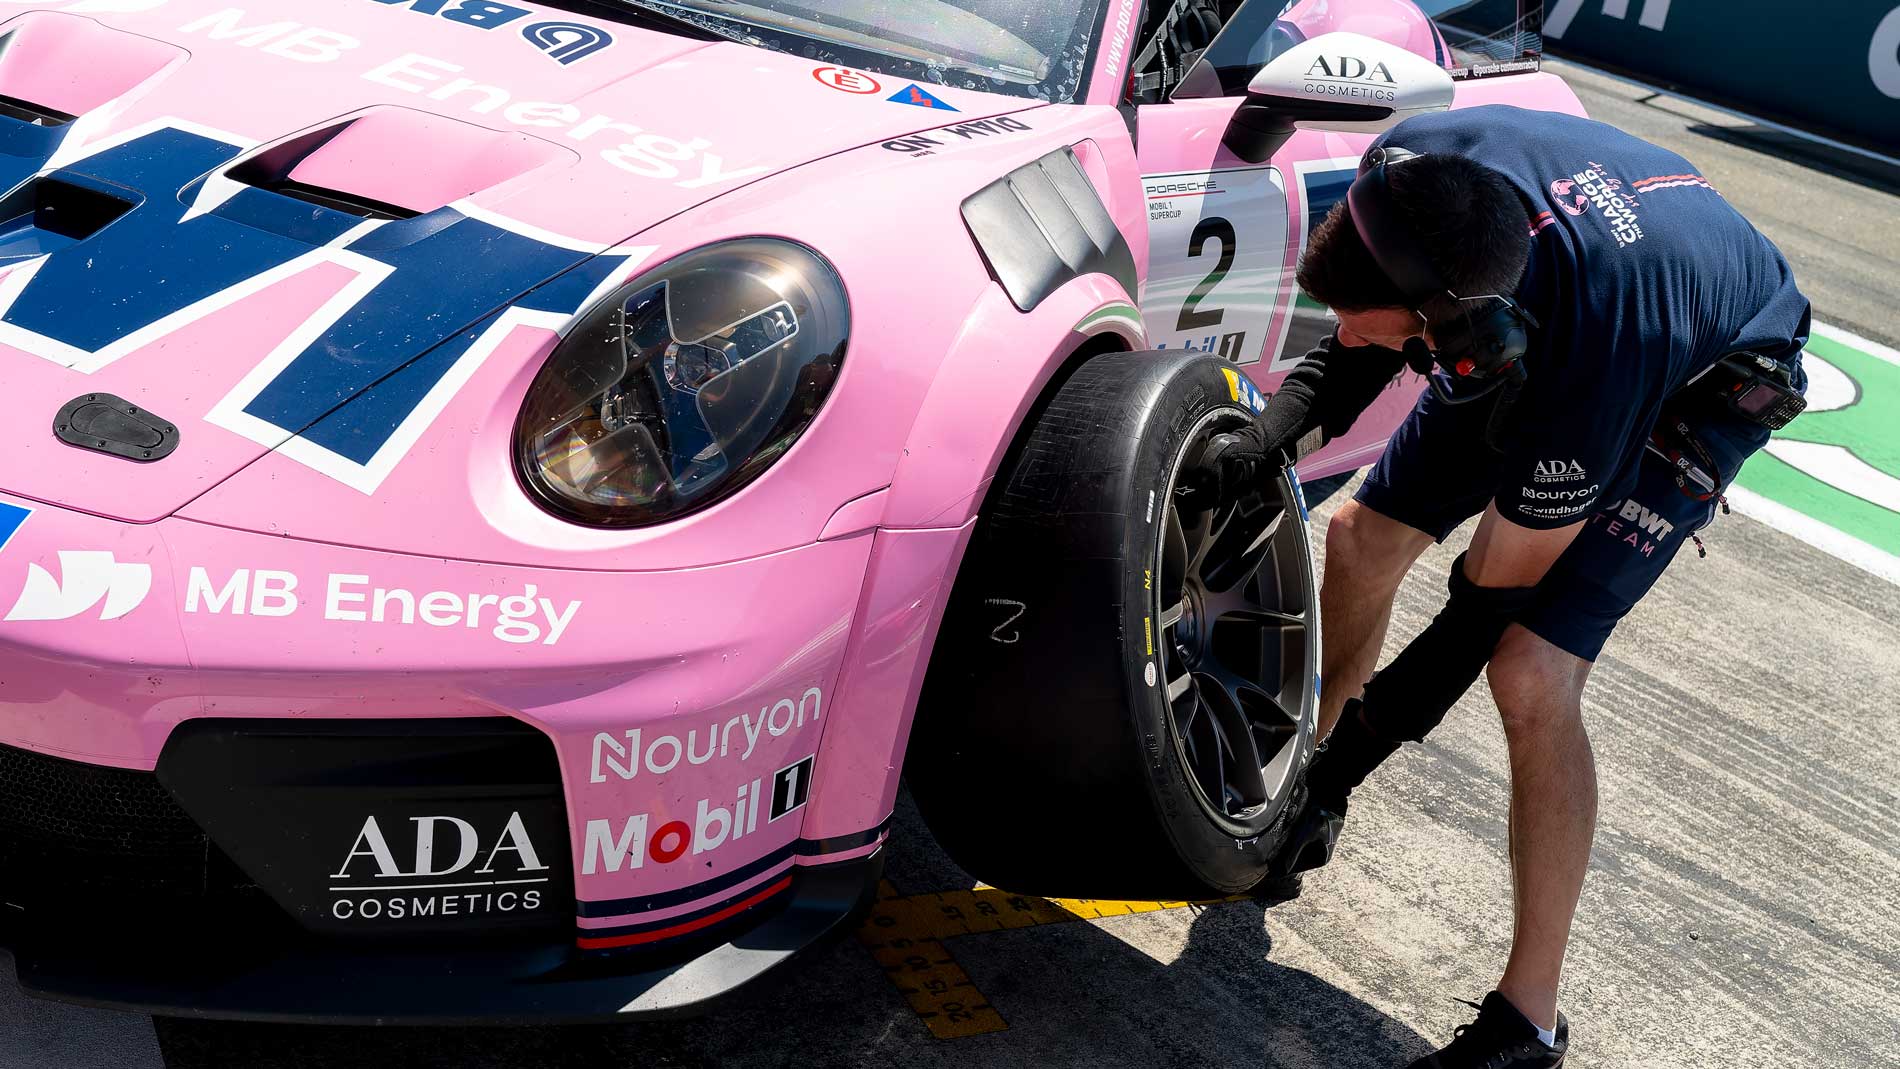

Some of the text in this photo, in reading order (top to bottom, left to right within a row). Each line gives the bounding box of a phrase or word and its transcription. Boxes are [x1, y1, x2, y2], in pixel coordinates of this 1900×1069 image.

[1303, 54, 1397, 84] ADA
[178, 7, 769, 188] MB Energy
[1304, 83, 1396, 102] COSMETICS
[881, 116, 1033, 152] DIAMND
[1146, 181, 1217, 194] PORSCHE
[1149, 202, 1168, 211] MOBIL
[1584, 169, 1638, 224] WORLD
[1150, 210, 1181, 220] SUPERCUP
[1573, 172, 1637, 244] CHANGE
[1176, 217, 1236, 331] 2
[1534, 459, 1586, 474] ADA
[1534, 475, 1586, 483] COSMETICS
[1522, 484, 1599, 500] Nouryon
[1592, 513, 1656, 558] TEAM
[1619, 499, 1674, 541] BWT
[184, 565, 582, 645] MB Energy
[590, 686, 822, 784] Nouryon
[329, 811, 549, 878] ADA
[581, 778, 762, 876] Mobil
[332, 890, 542, 920] COSMETICS
